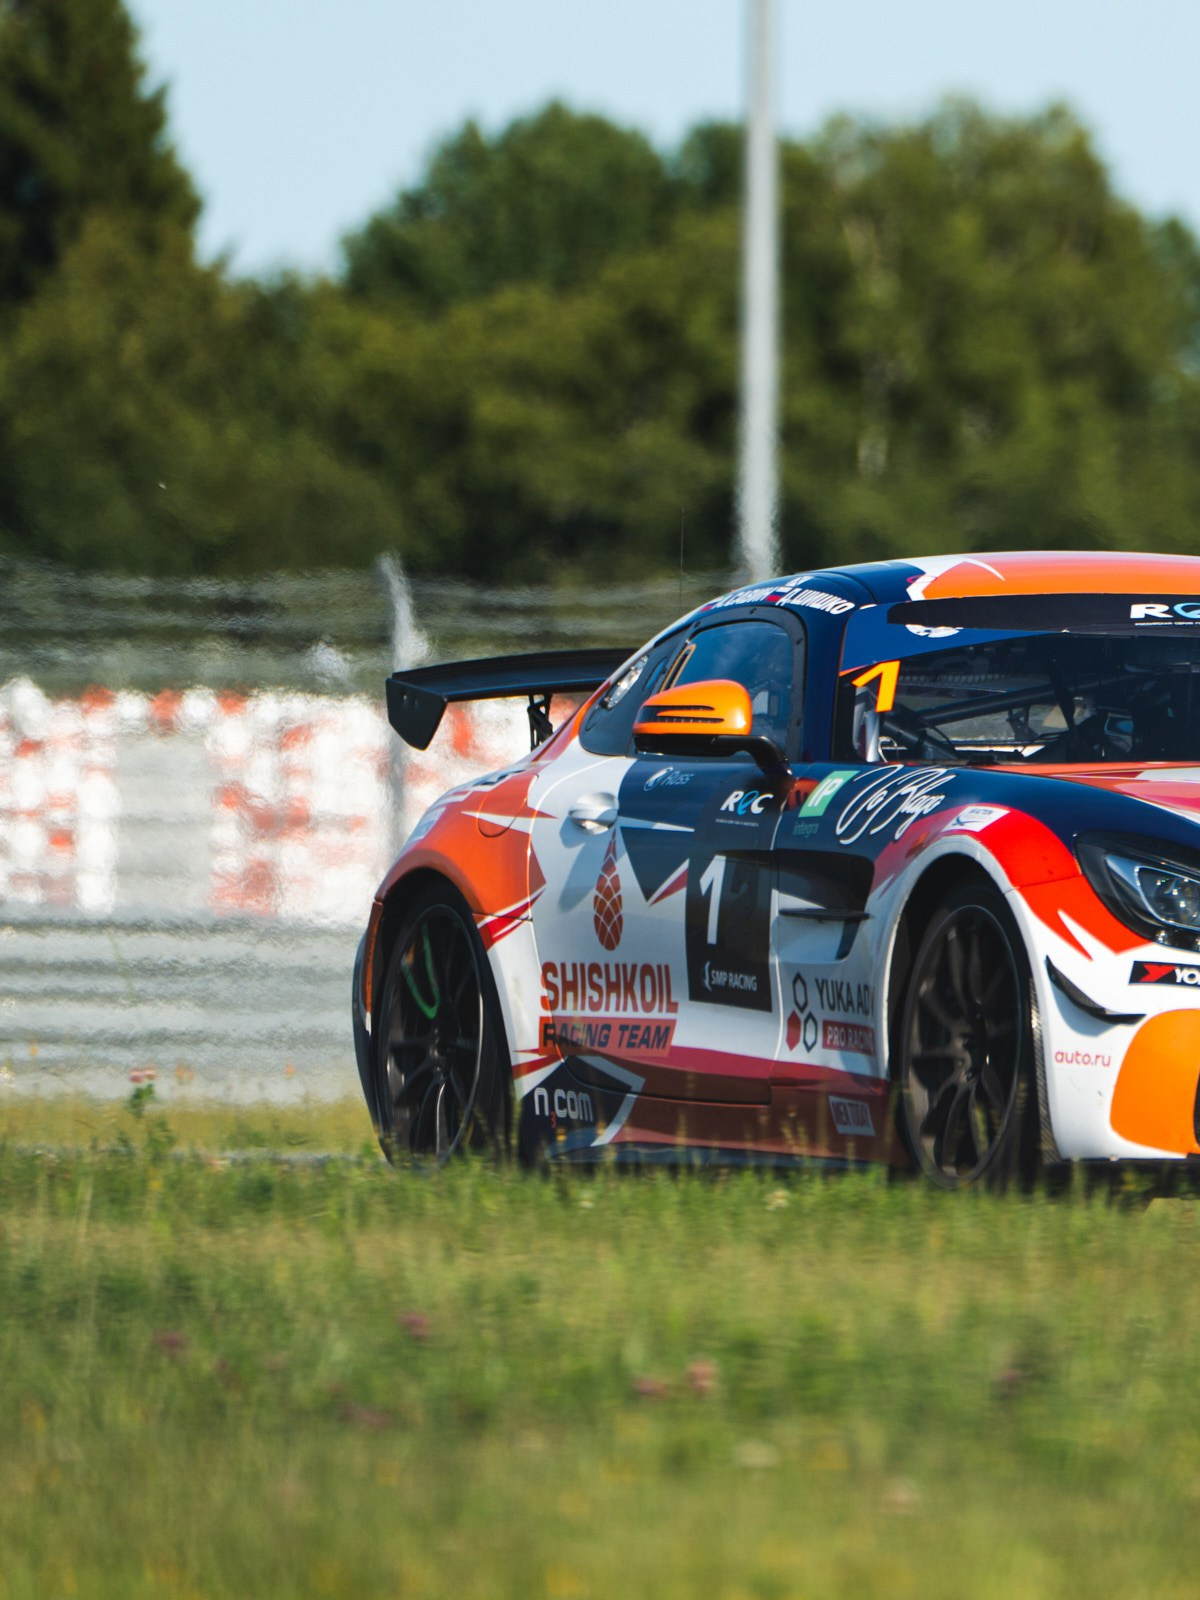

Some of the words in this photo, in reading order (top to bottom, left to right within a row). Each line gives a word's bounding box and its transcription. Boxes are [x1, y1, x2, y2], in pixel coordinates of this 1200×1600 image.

[852, 660, 900, 713] 1
[699, 854, 727, 945] 1
[540, 961, 679, 1014] SHISHKOIL
[728, 972, 758, 991] RACING
[815, 978, 855, 1013] YUKA
[542, 1023, 612, 1048] RACING
[617, 1023, 671, 1050] TEAM
[1054, 1049, 1111, 1068] auto.ru
